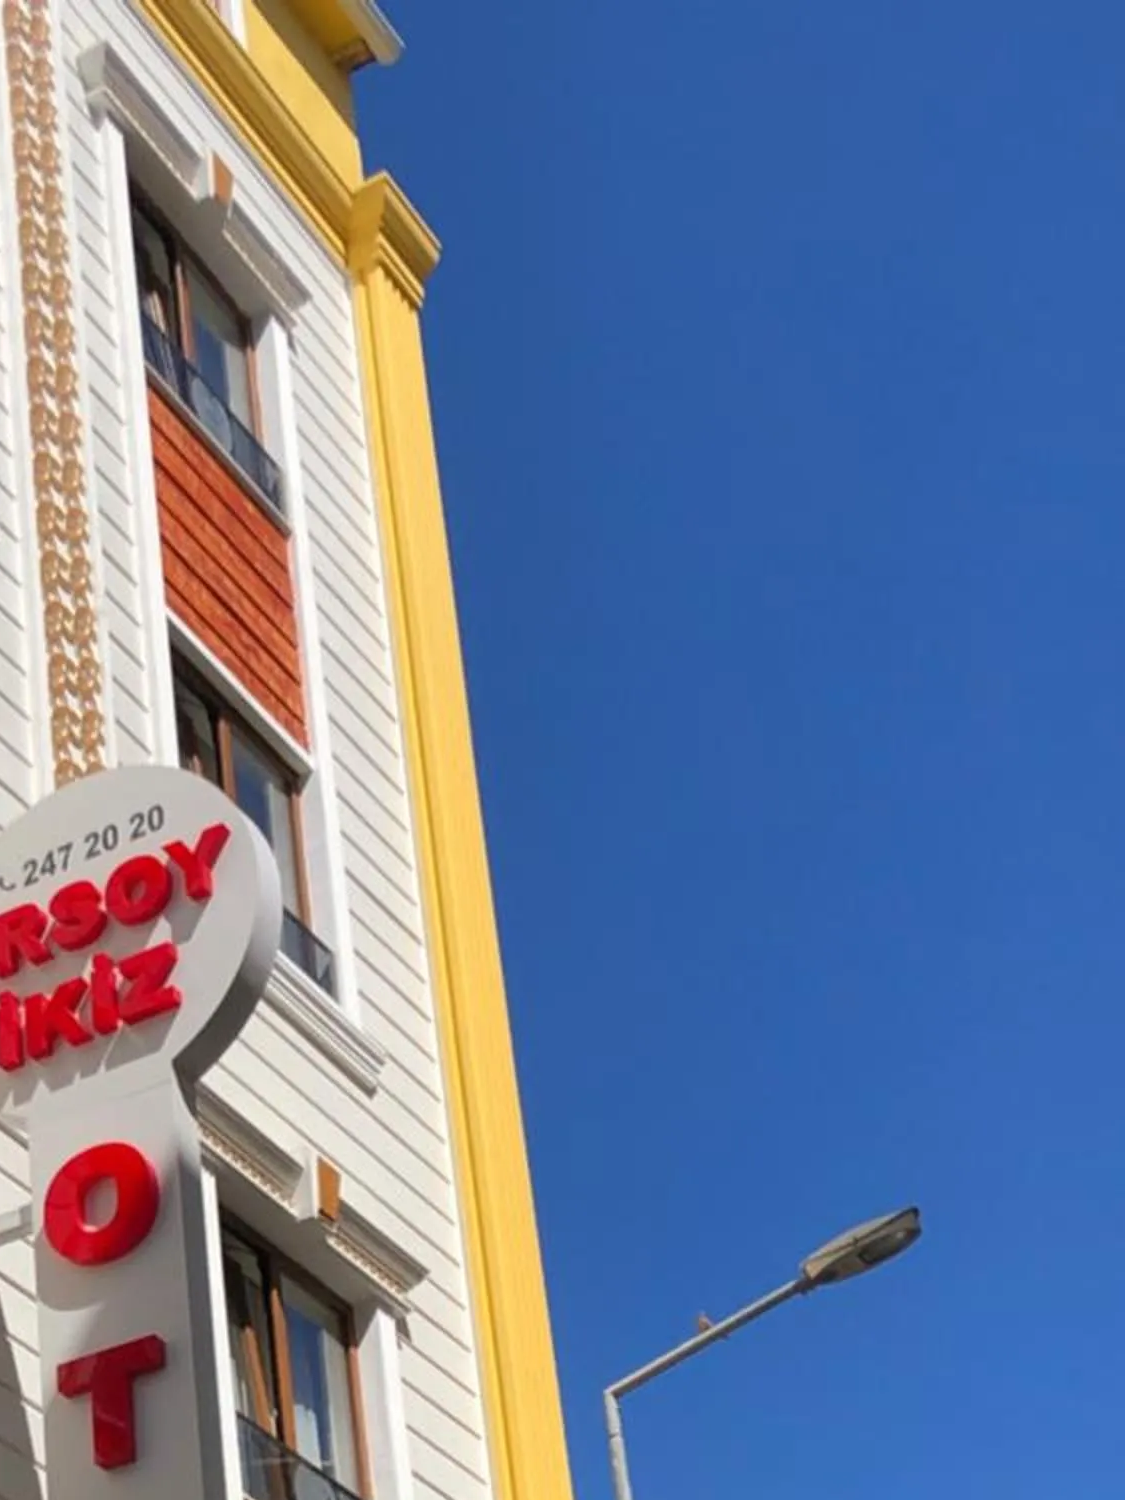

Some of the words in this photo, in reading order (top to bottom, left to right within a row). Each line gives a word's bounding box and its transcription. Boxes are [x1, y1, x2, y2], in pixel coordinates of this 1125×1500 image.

[23, 842, 73, 887] 247
[84, 824, 119, 860] 20
[129, 804, 165, 841] 20
